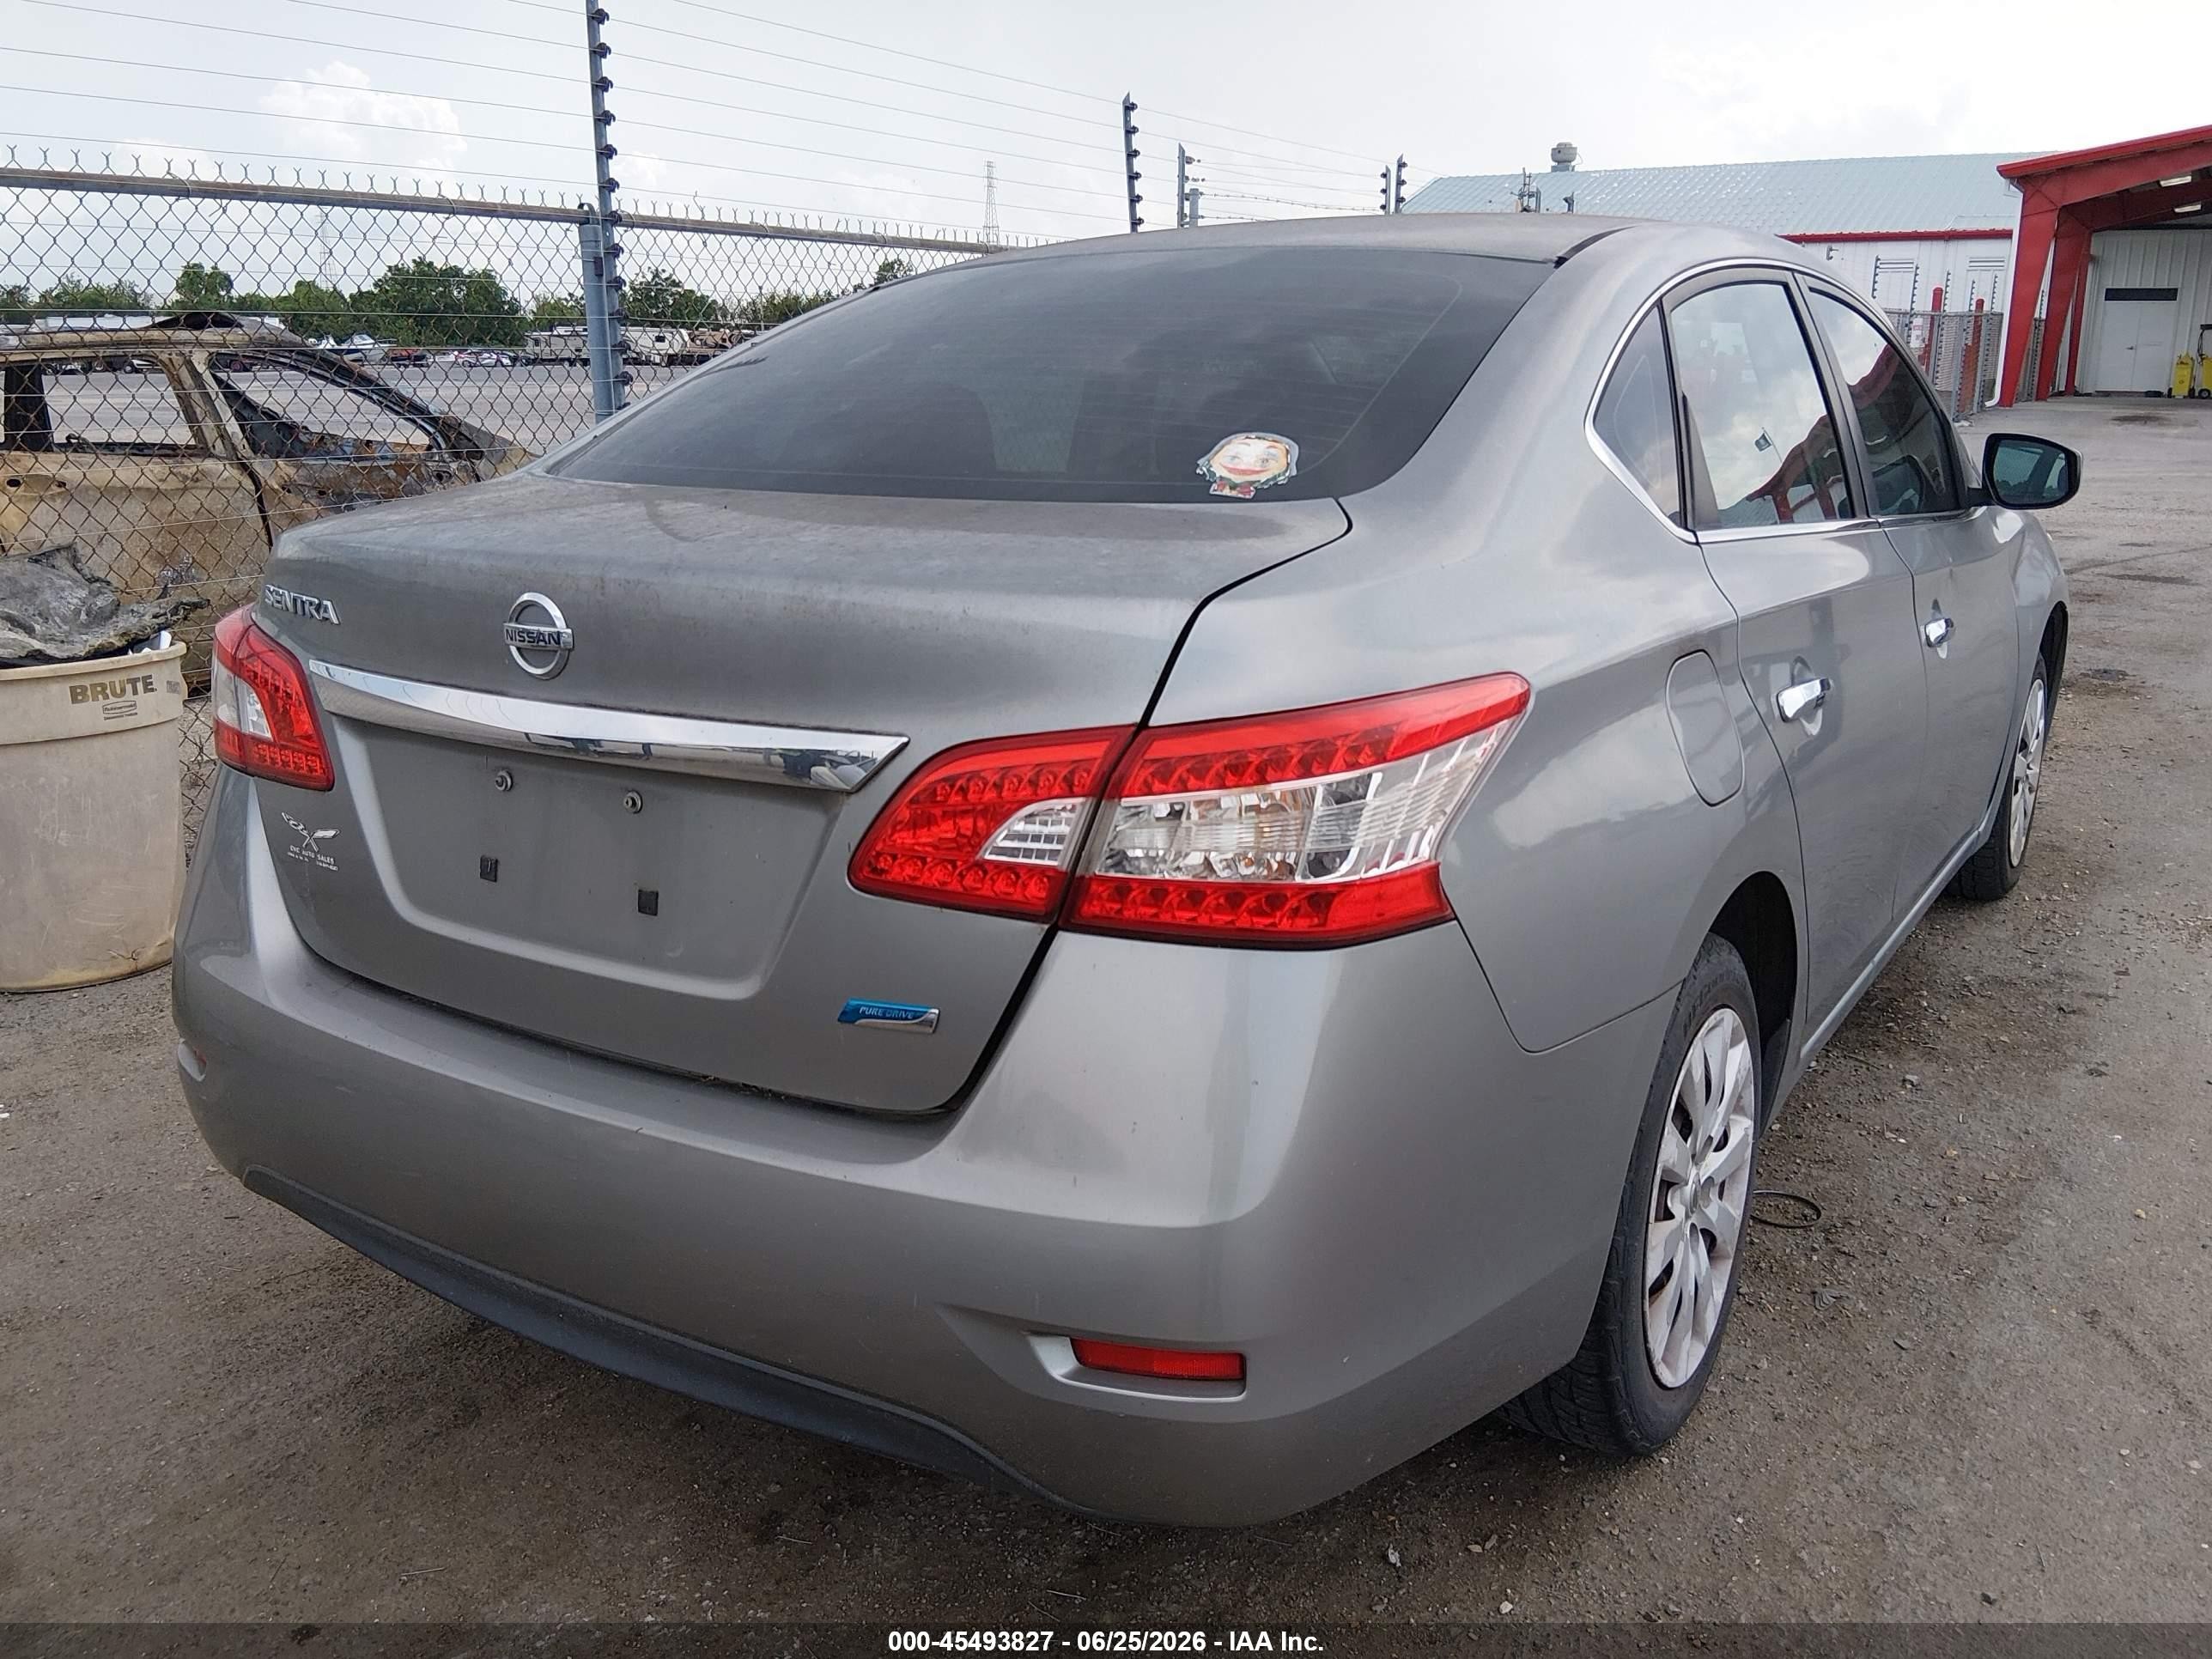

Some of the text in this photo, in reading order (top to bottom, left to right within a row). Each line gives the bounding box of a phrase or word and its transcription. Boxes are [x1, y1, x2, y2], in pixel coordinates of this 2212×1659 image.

[264, 584, 340, 625] SENTRA
[506, 629, 561, 645] NISSAN
[317, 854, 334, 865] SALES
[859, 1006, 914, 1019] PURE DRIVE
